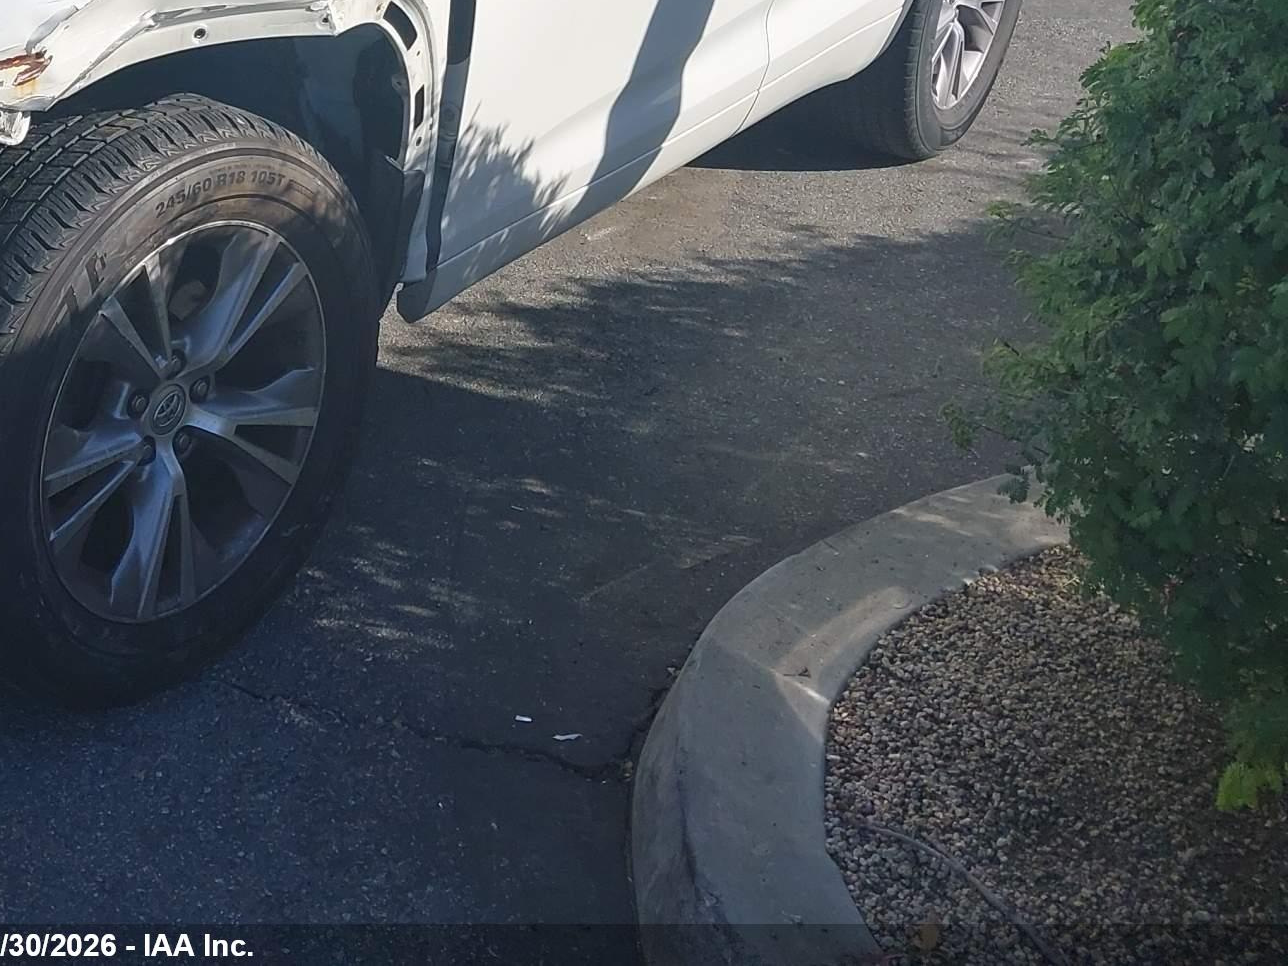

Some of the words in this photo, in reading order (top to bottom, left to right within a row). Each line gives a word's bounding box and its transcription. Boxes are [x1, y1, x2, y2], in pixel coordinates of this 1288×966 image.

[155, 177, 212, 218] 245/60
[216, 170, 246, 186] R18
[250, 170, 286, 187] 105T
